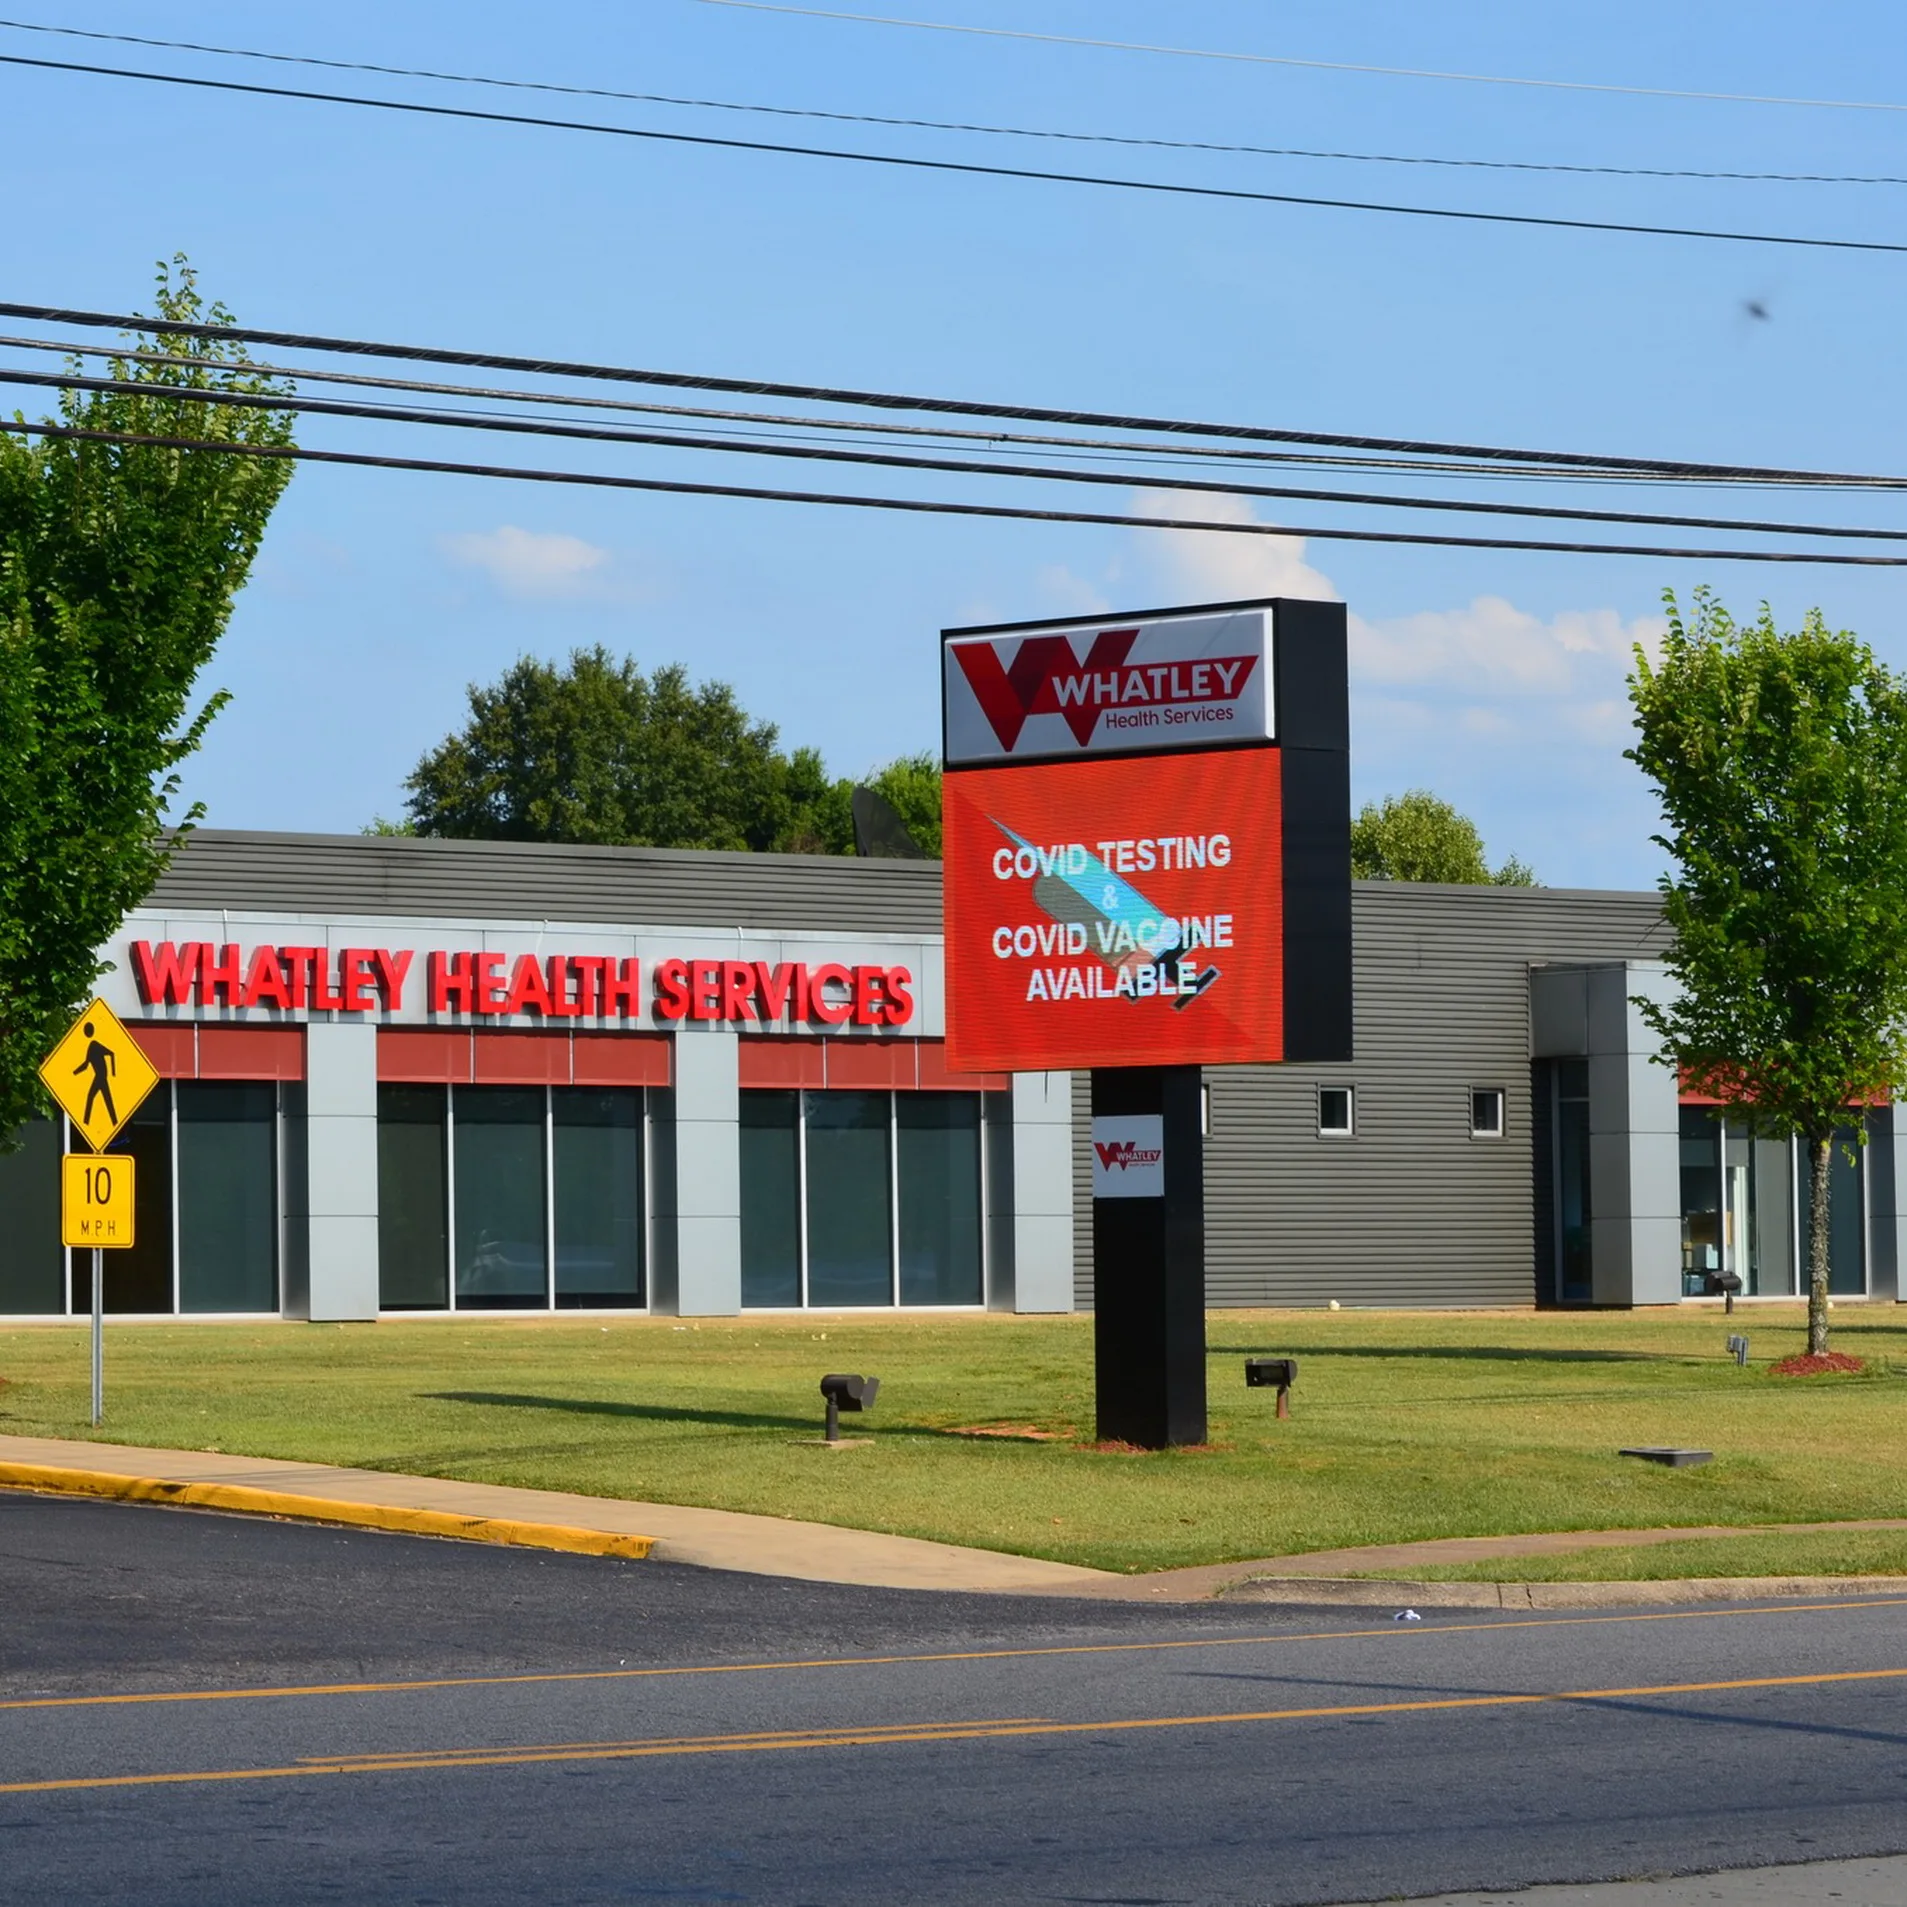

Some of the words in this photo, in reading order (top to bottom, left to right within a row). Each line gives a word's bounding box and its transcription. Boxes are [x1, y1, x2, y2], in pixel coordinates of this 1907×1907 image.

[1052, 661, 1242, 707] WHATLEY
[1106, 709, 1159, 729] Health
[1163, 707, 1234, 725] Services
[993, 843, 1087, 880] COVID
[1097, 834, 1232, 873] TESTING
[1102, 885, 1119, 909] &
[992, 922, 1088, 959] COVID
[130, 940, 413, 1011] WHATLEY
[428, 950, 640, 1018] HEALTH
[652, 958, 914, 1026] SERVICES
[1026, 962, 1198, 1002] AVAILABLE
[1116, 1151, 1159, 1161] WHATLEY
[85, 1167, 112, 1205] 10
